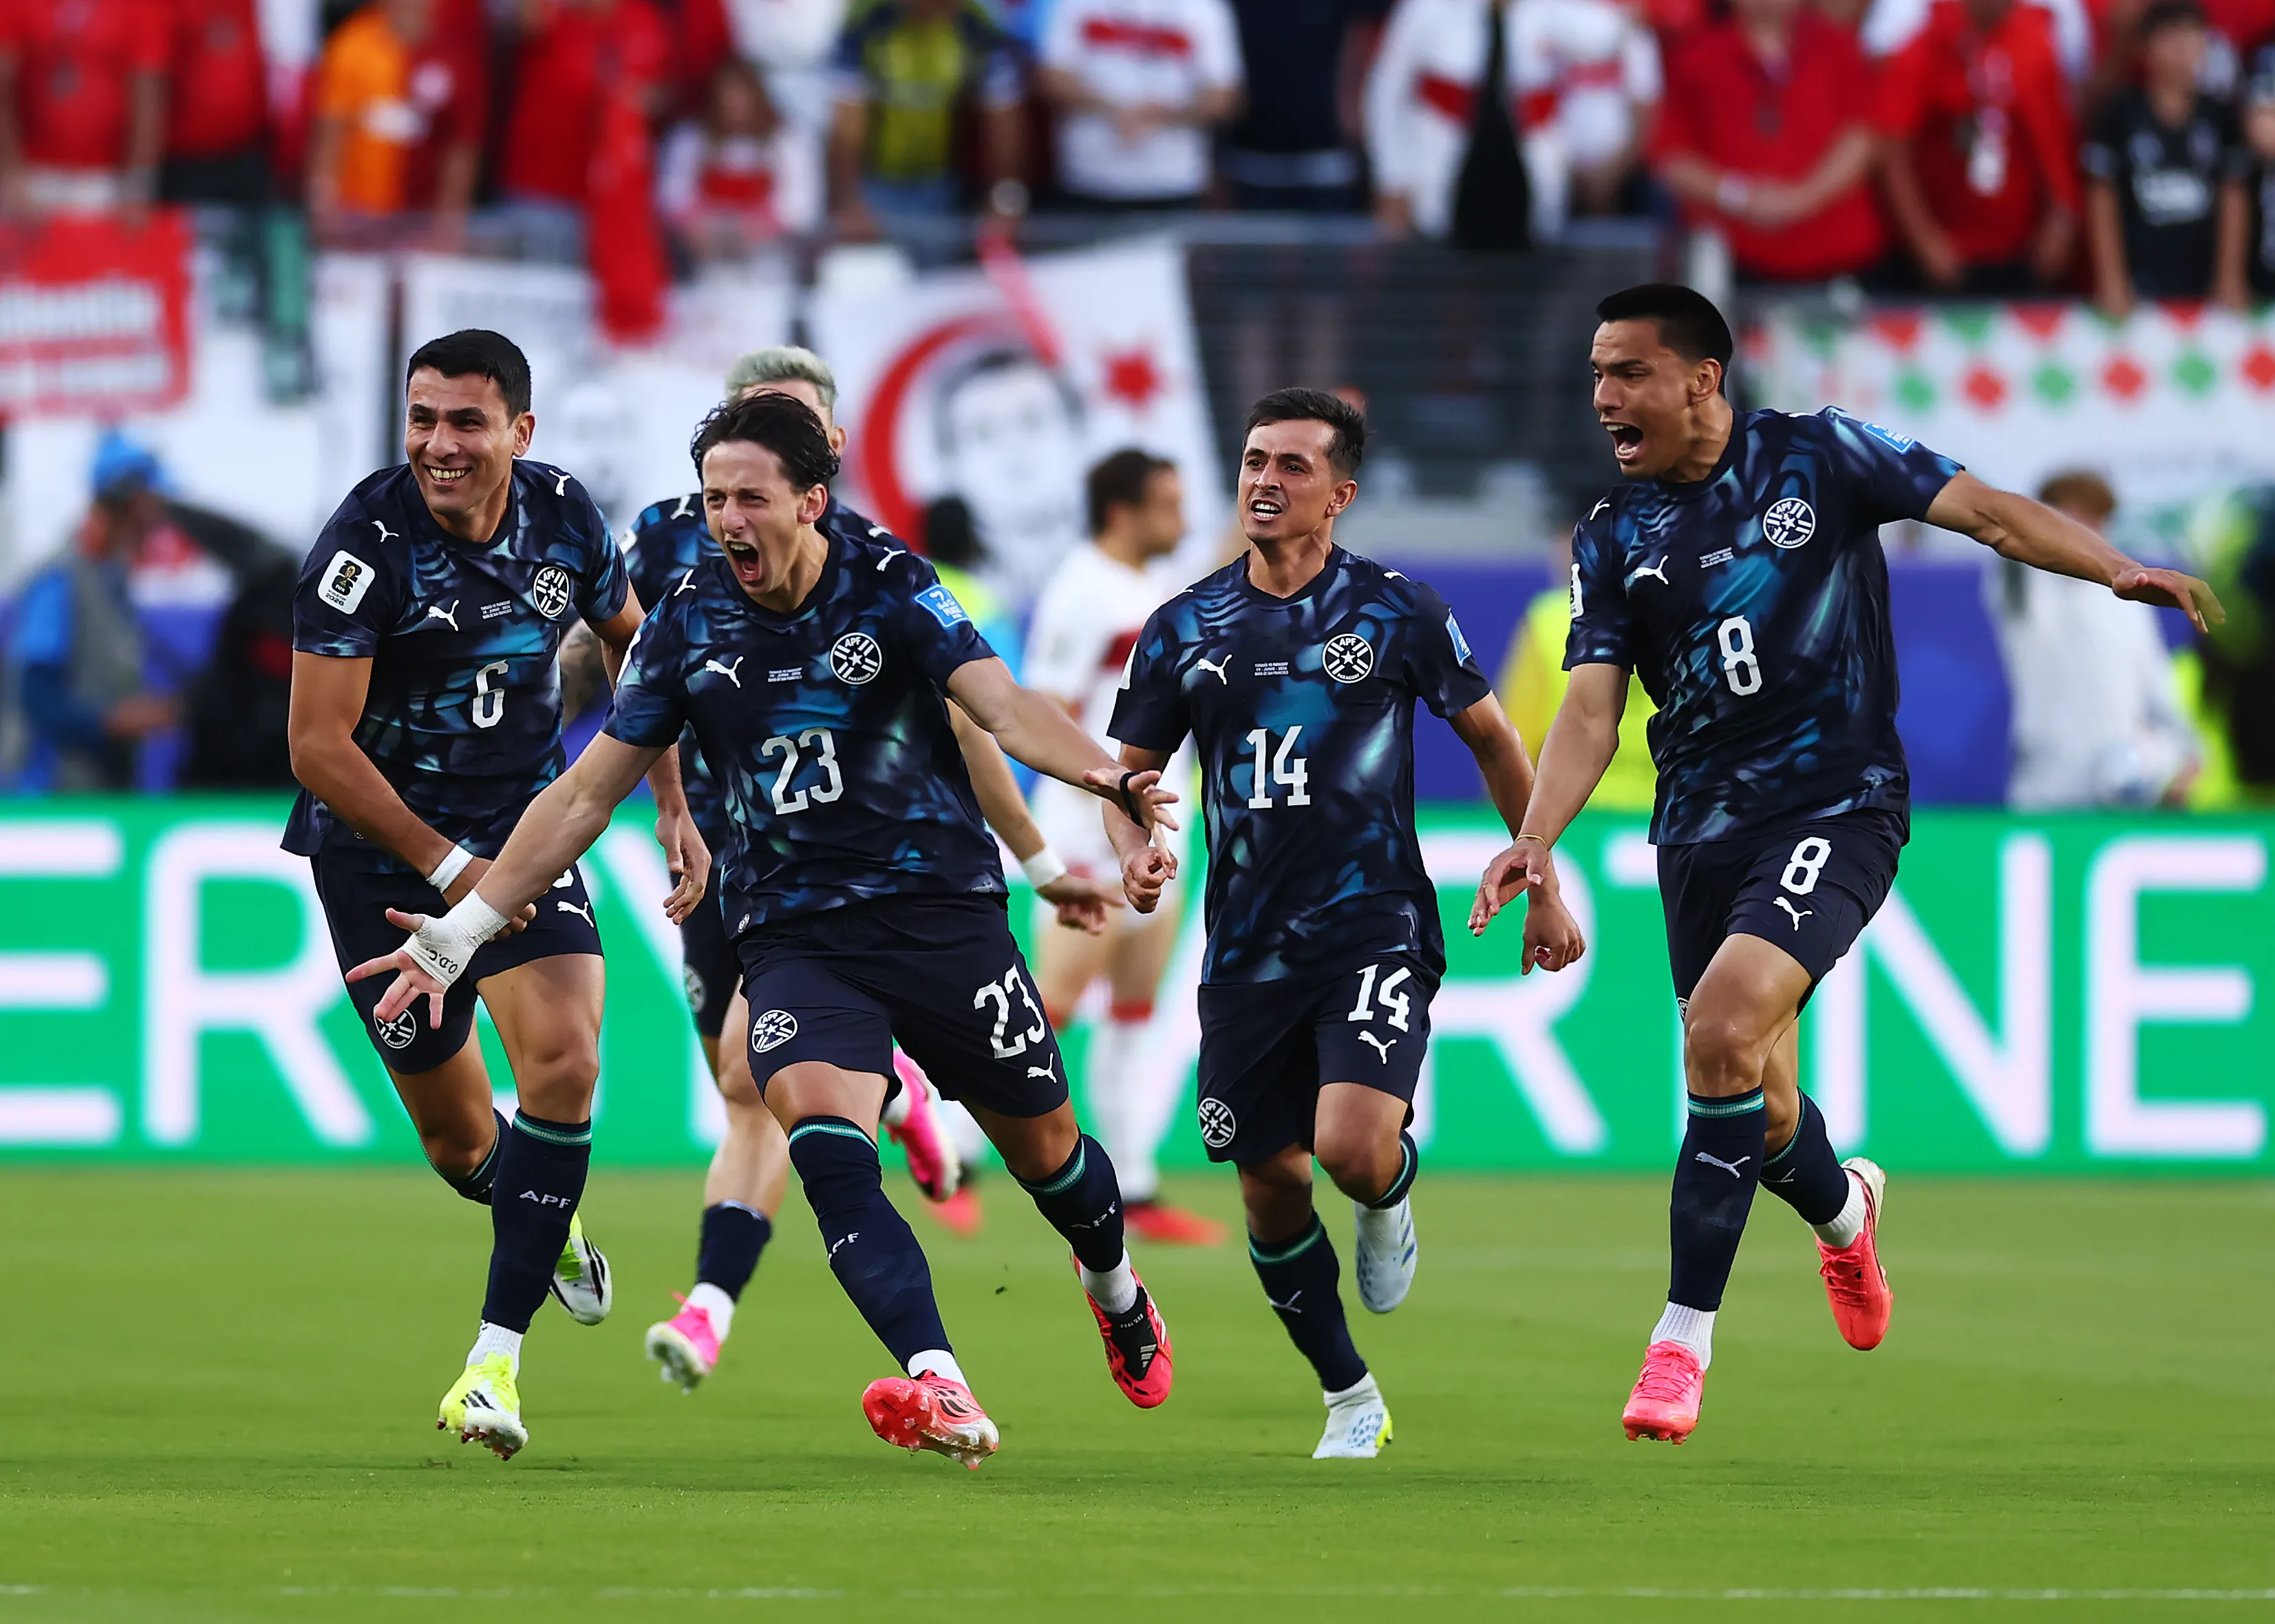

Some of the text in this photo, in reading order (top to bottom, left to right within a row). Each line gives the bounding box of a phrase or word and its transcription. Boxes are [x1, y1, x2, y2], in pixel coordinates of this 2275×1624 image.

[1776, 501, 1792, 513] APF
[543, 569, 555, 581] APF
[335, 584, 345, 592] FIFA
[325, 592, 344, 606] 2026
[845, 637, 861, 647] APF
[1339, 638, 1356, 646] APF
[1718, 615, 1762, 696] 8
[473, 659, 509, 729] 6
[761, 727, 844, 815] 23
[1246, 725, 1310, 809] 14
[1780, 837, 1832, 895] 8
[1347, 963, 1411, 1033] 14
[762, 1012, 778, 1024] APF
[973, 963, 1045, 1059] 23
[1206, 1102, 1216, 1111] APF
[519, 1190, 570, 1208] APF
